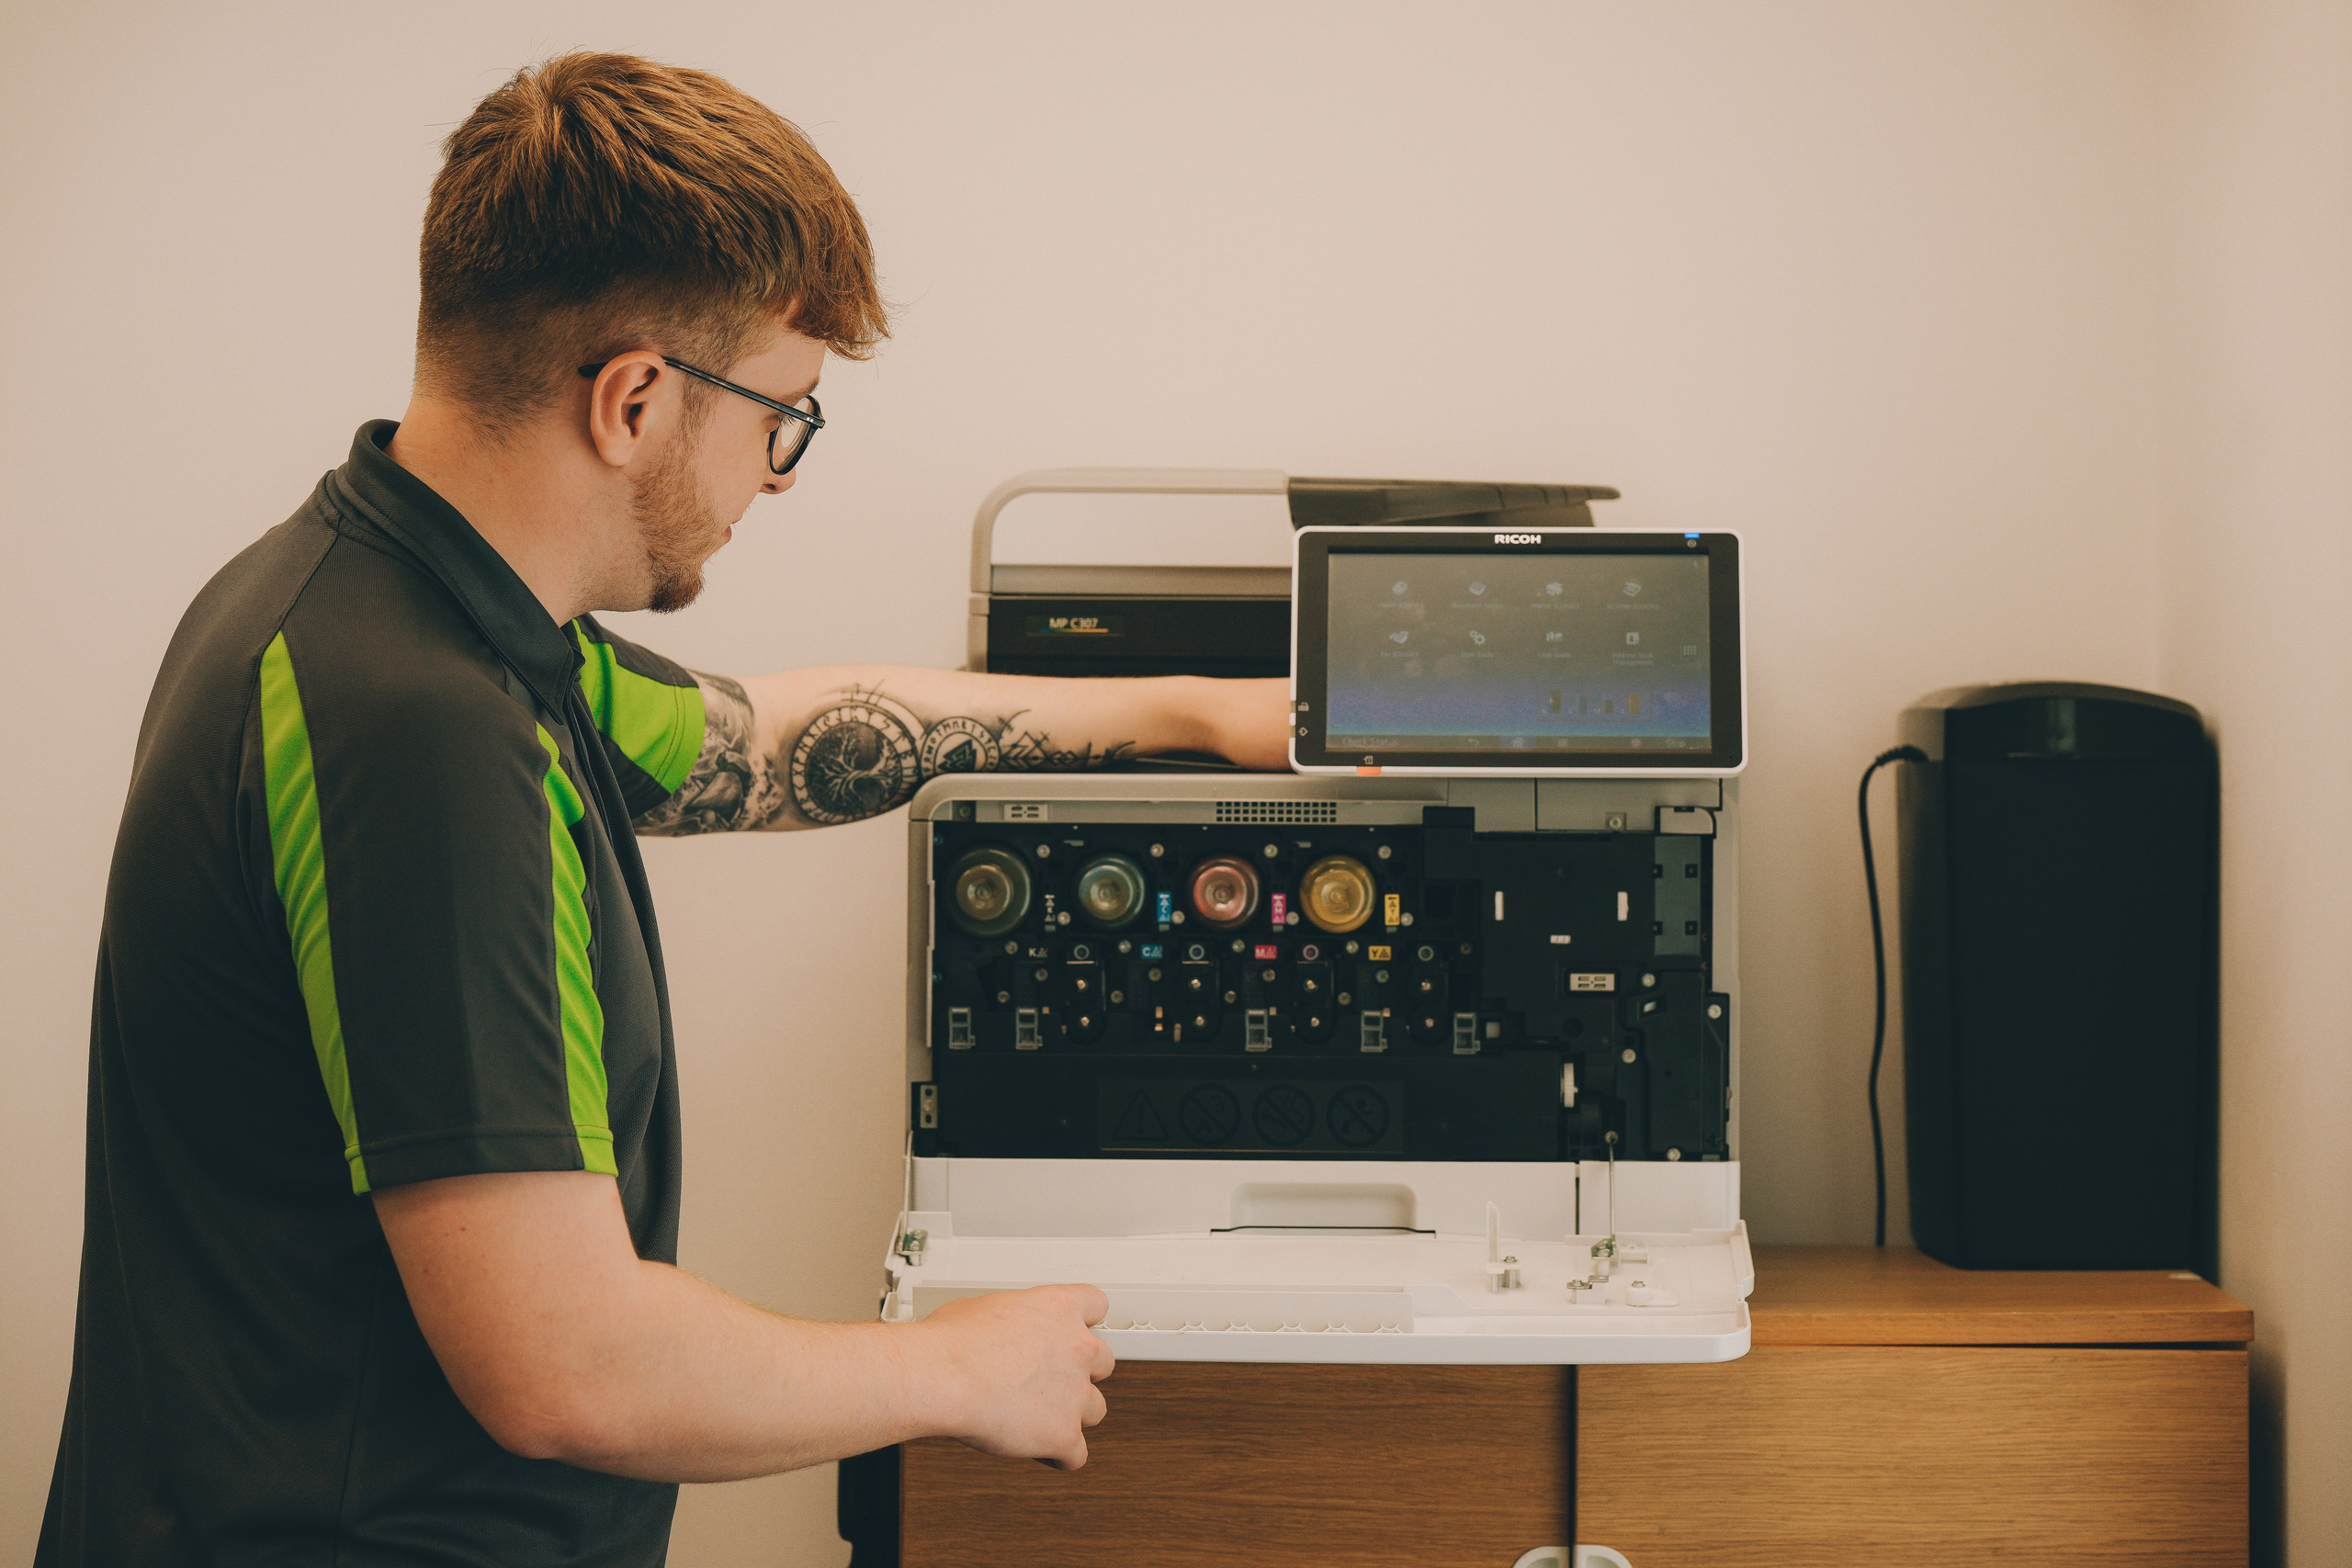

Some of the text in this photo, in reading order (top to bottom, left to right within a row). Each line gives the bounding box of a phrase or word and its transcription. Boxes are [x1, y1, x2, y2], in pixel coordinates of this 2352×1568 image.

[1494, 534, 1542, 545] RICOH
[1048, 617, 1099, 629] MP C307
[1142, 946, 1151, 957] C
